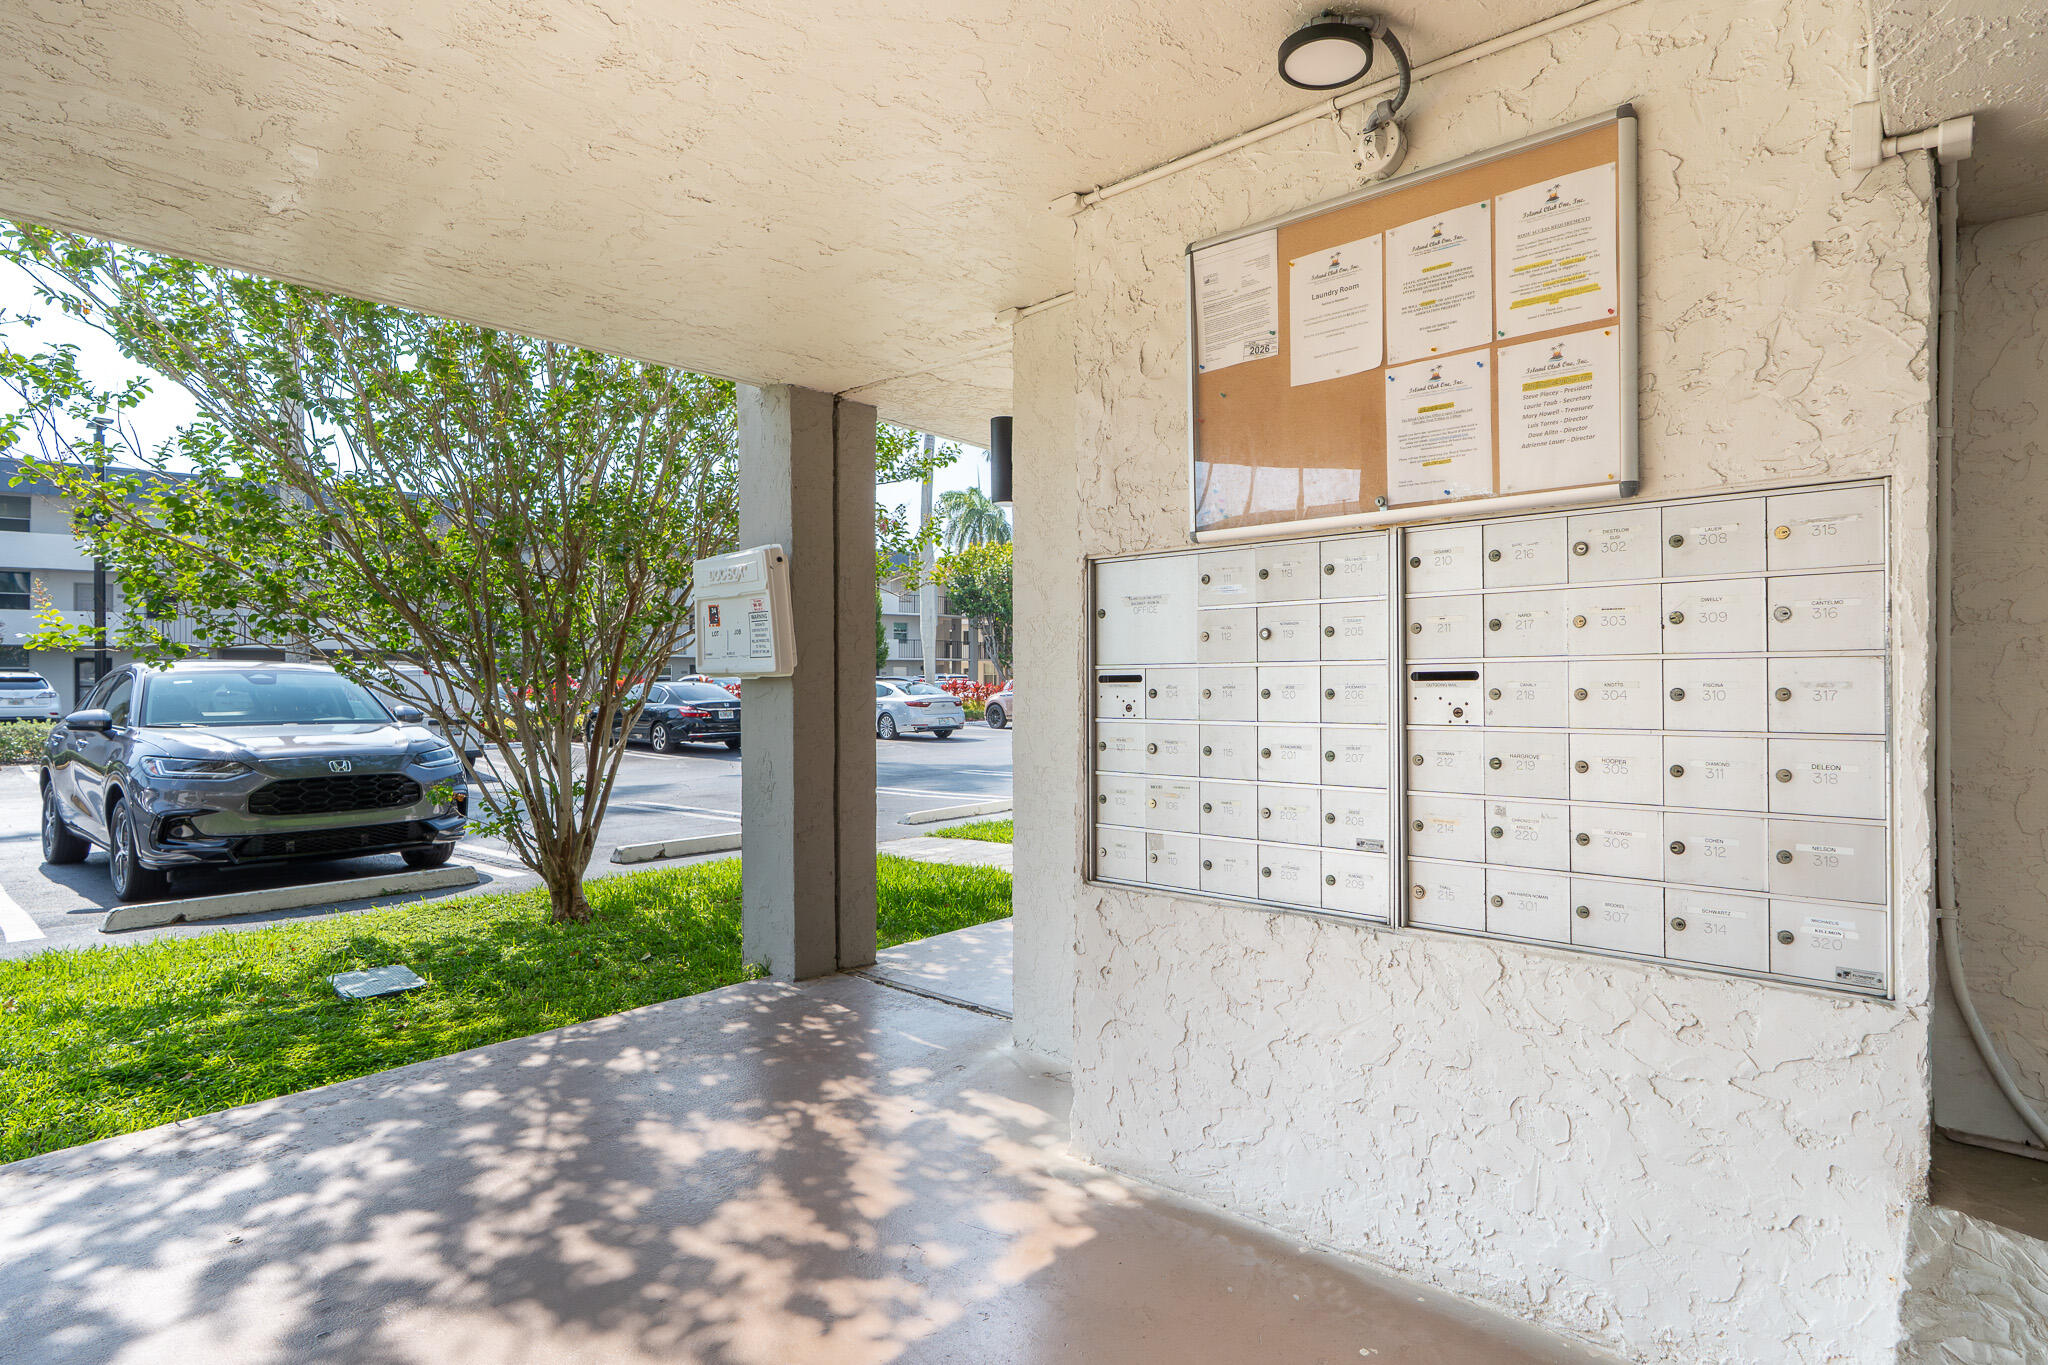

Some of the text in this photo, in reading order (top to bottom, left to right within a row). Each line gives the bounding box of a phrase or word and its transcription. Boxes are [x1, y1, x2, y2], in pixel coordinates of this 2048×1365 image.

[1544, 204, 1556, 212] Club
[1311, 288, 1338, 301] Laundry
[1339, 283, 1360, 293] Room
[1250, 345, 1270, 355] 2026
[1547, 362, 1560, 370] Club
[1564, 384, 1592, 394] President
[1563, 395, 1592, 404] Secretary
[1565, 404, 1594, 413] Treasurer
[1571, 434, 1595, 442] Director
[1811, 525, 1837, 537] 315
[1699, 532, 1728, 546] 308
[1601, 541, 1626, 553] 302
[1515, 549, 1534, 560] 216
[1434, 556, 1453, 567] 210
[1344, 564, 1363, 575] 204
[1133, 606, 1158, 614] OFFICE
[1812, 607, 1838, 619] 316
[1601, 616, 1626, 627] 303
[1699, 611, 1727, 624] 309
[1515, 620, 1534, 630] 217
[1344, 627, 1364, 637] 205
[1344, 690, 1364, 700] 206
[1516, 689, 1535, 701] 218
[1602, 690, 1627, 701] 304
[1702, 690, 1726, 701] 310
[1812, 690, 1838, 702] 317
[1281, 751, 1296, 760] 201
[1345, 754, 1364, 763] 207
[1516, 761, 1535, 771] 219
[1602, 764, 1628, 775] 305
[1705, 768, 1724, 780] 311
[1812, 773, 1839, 784] 318
[1280, 812, 1297, 820] 202
[1345, 817, 1364, 826] 208
[1514, 831, 1538, 841] 220
[1603, 838, 1629, 849] 306
[1704, 846, 1727, 858] 312
[1812, 856, 1840, 867] 319
[1281, 872, 1297, 881] 203
[1345, 880, 1365, 889] 209
[1518, 900, 1538, 912] 301
[1603, 911, 1629, 922] 307
[1701, 908, 1731, 916] SCHWARTZ
[1704, 922, 1727, 935] 314
[1811, 938, 1842, 951] 320
